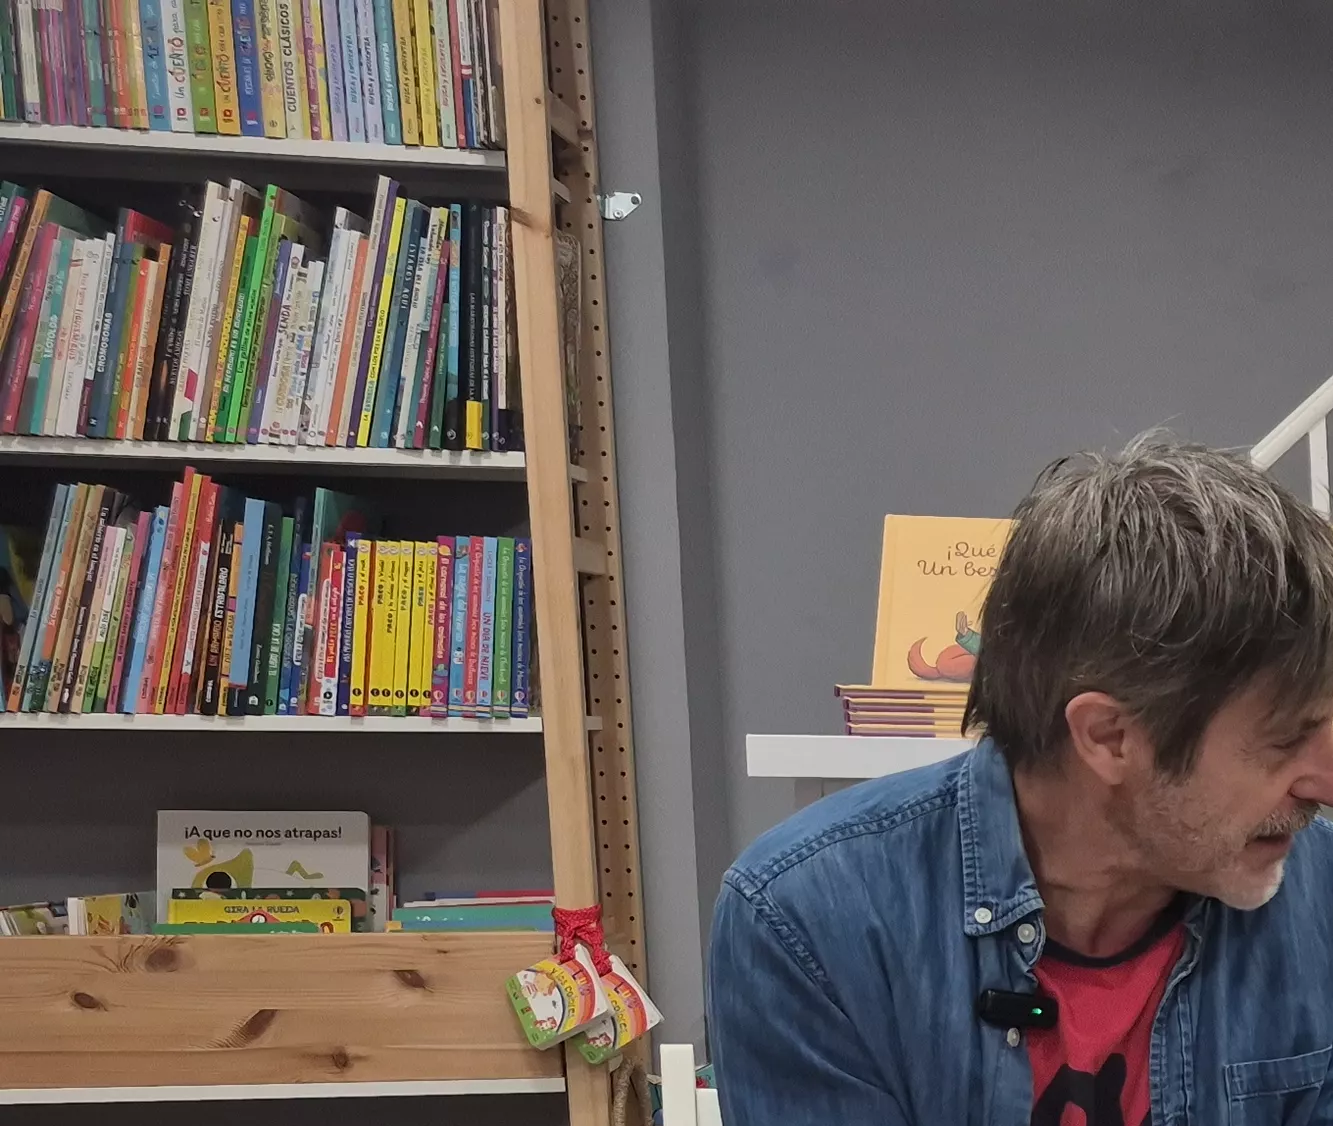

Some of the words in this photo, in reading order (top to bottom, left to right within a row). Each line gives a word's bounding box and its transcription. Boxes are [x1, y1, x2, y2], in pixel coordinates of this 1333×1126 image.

[278, 3, 292, 56] CLÁSICOS
[284, 60, 297, 112] CUENTOS
[96, 312, 113, 372] CROMOSOMAS
[948, 542, 997, 560] ¡Qué
[917, 560, 957, 575] Un
[964, 561, 997, 577] bes
[213, 567, 229, 618] ESTRAFALARIO
[439, 566, 449, 598] carnaval
[439, 600, 447, 610] de
[438, 613, 446, 623] los
[482, 612, 490, 625] UN
[436, 626, 445, 658] animales
[480, 657, 488, 681] NIEVE
[184, 826, 200, 839] ¡A
[204, 828, 230, 844] que
[234, 829, 252, 839] no
[256, 829, 281, 839] nos
[285, 827, 342, 842] atrapas!
